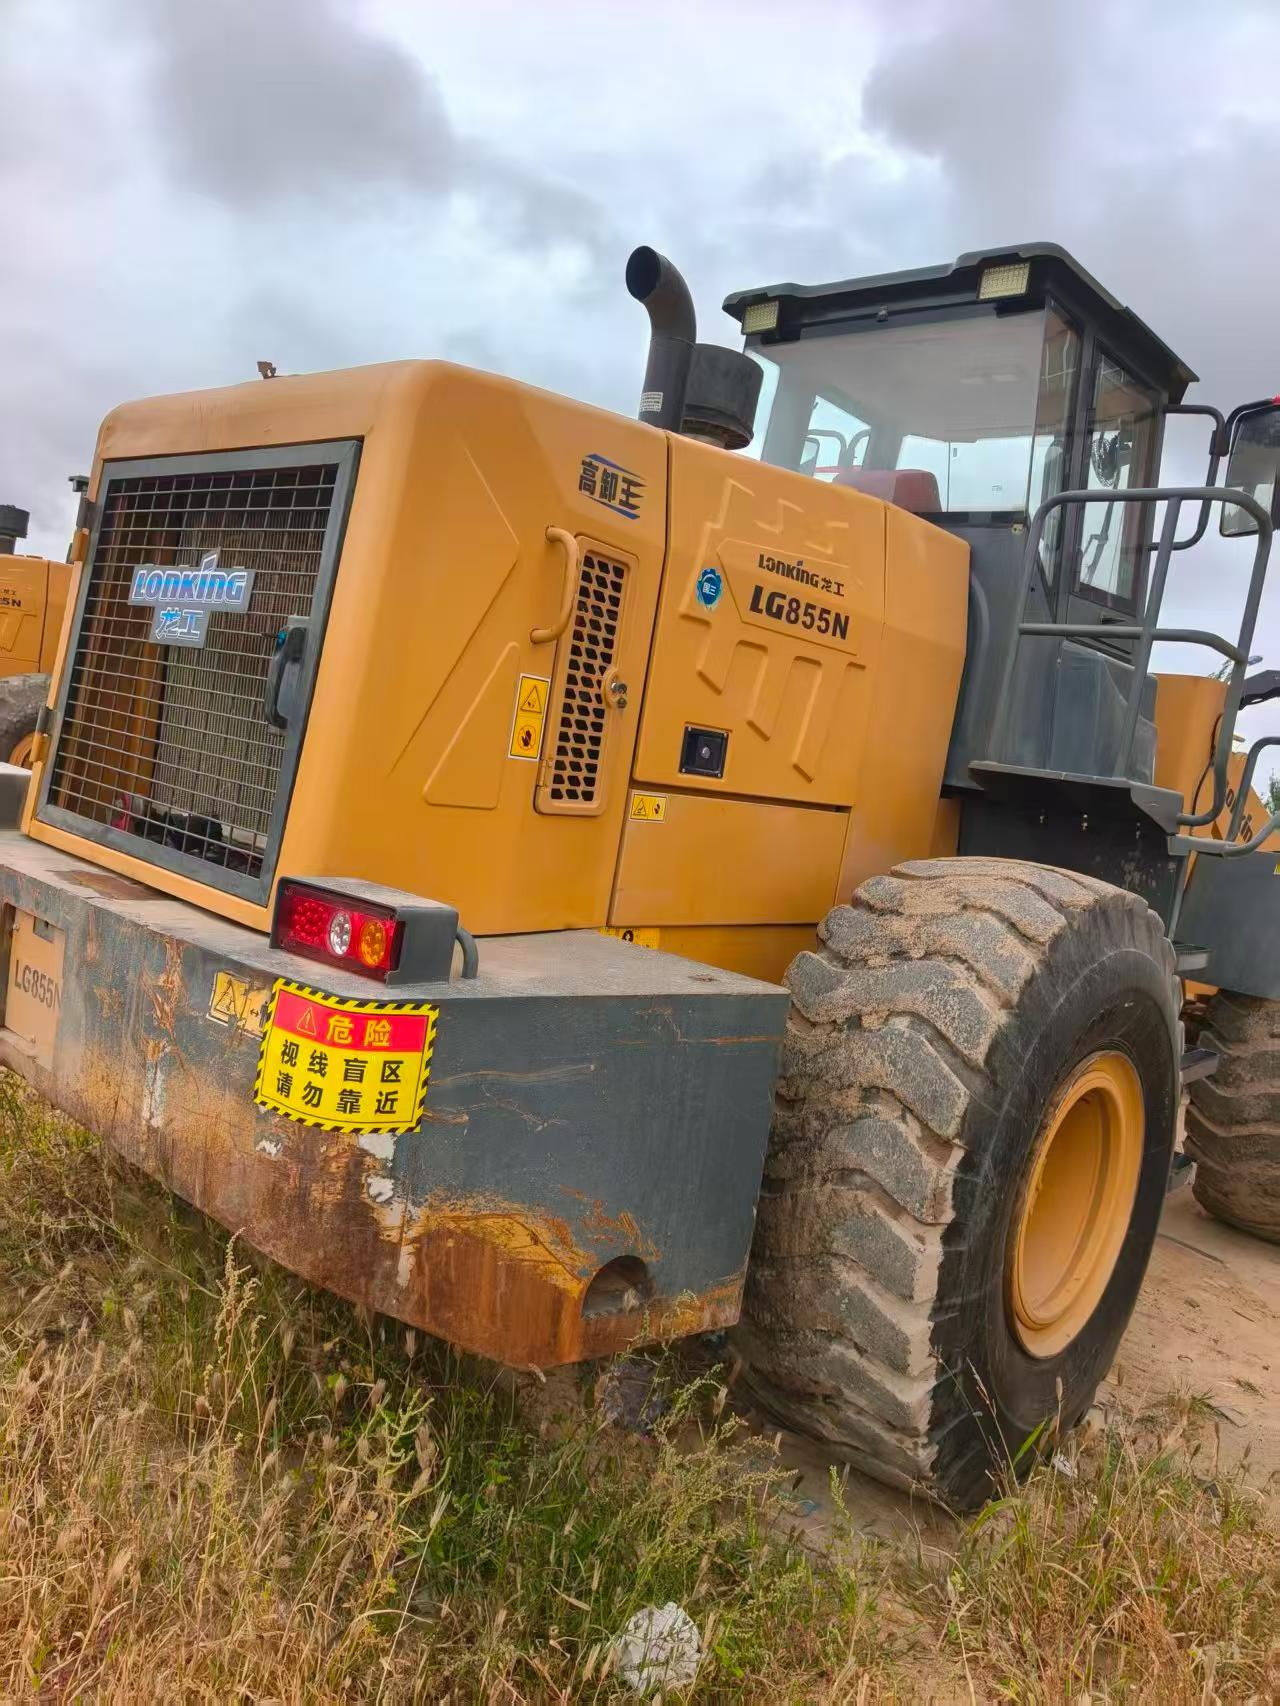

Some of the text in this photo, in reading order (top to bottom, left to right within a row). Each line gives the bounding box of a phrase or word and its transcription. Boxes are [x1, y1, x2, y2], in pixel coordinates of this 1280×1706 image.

[155, 606, 204, 640] 龙工
[749, 584, 850, 641] LG855N
[326, 1014, 393, 1048] 危险
[279, 1038, 405, 1084] 视线盲区
[276, 1069, 400, 1116] 请勿靠近
